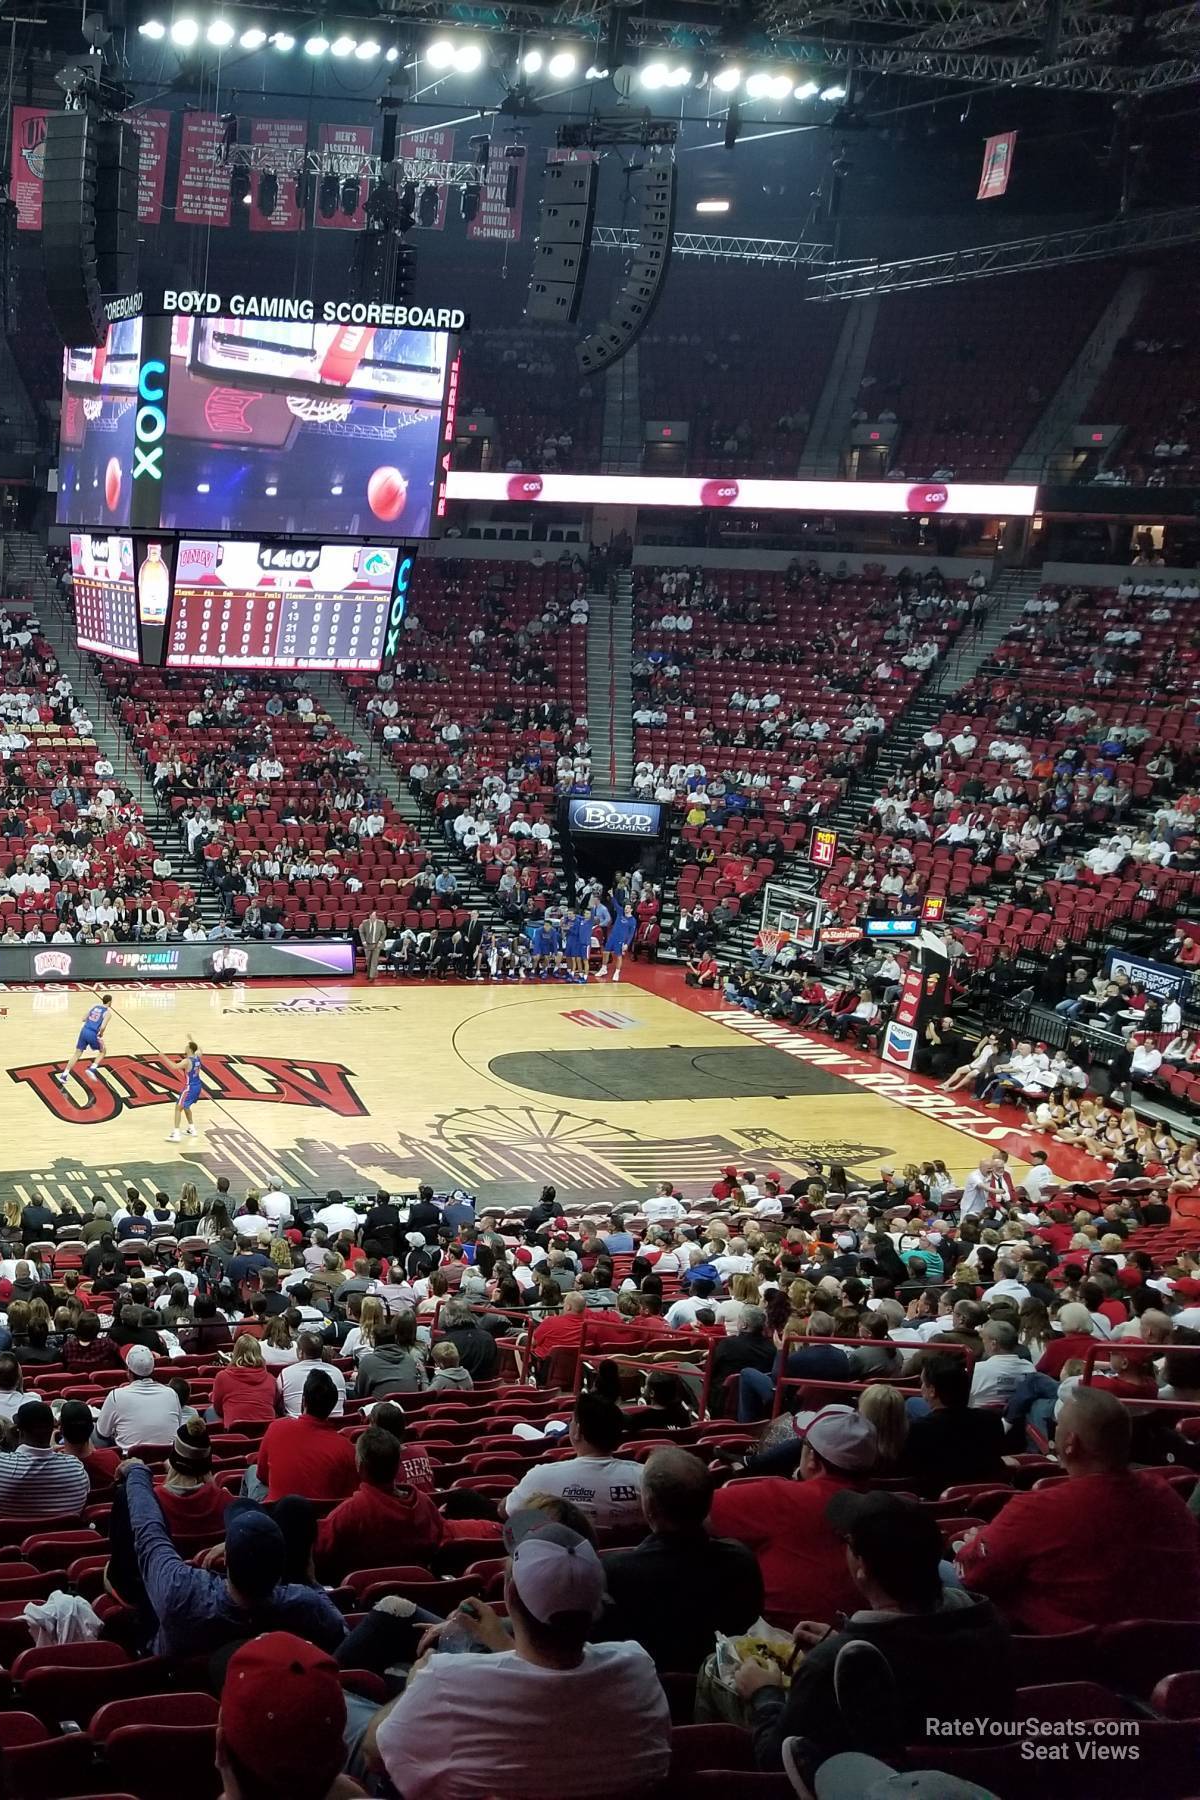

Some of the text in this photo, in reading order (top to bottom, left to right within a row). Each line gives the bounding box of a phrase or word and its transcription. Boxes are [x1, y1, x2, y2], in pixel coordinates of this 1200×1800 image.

[336, 131, 356, 142] MEN'S
[416, 147, 438, 159] MEN'S
[487, 186, 506, 200] WAC
[163, 290, 465, 330] BOYD GAMING SCOREBOARD
[133, 360, 166, 480] COX
[180, 549, 214, 568] UNLV
[260, 549, 320, 569] 14:07
[181, 598, 275, 610] 1 0 3 0 0
[315, 603, 322, 611] 0
[334, 603, 341, 611] 0
[356, 603, 361, 612] 1
[377, 604, 384, 613] 0
[384, 557, 412, 656] COX
[203, 610, 274, 621] 0 0 1 0
[288, 613, 382, 624] 13 0 0 0 0
[176, 621, 272, 632] 13 0 0 0 0
[286, 624, 380, 635] 21 0 0 0 0
[174, 632, 269, 643] 20 4 1 0 1
[285, 635, 379, 646] 33 0 0 0 0
[173, 643, 269, 654] 30 0 0 0 0
[283, 646, 377, 656] 34 0 0 0 0
[584, 808, 652, 826] BOYD
[607, 824, 651, 832] GAMING
[814, 843, 830, 861] 30
[926, 908, 937, 917] 30
[106, 950, 180, 966] Peppermill
[1132, 968, 1148, 980] CBS
[44, 983, 68, 994] &
[70, 982, 155, 992] Mack
[160, 982, 250, 990] CENTER
[222, 1006, 332, 1015] AMERICA
[335, 1004, 402, 1014] FIRST
[892, 1024, 913, 1038] Chevron
[700, 1010, 872, 1069] RUNNIN'
[6, 1054, 371, 1124] UNLV
[842, 1070, 1028, 1140] REBELS
[814, 1150, 880, 1158] VEGAS
[562, 1487, 596, 1498] Findlay
